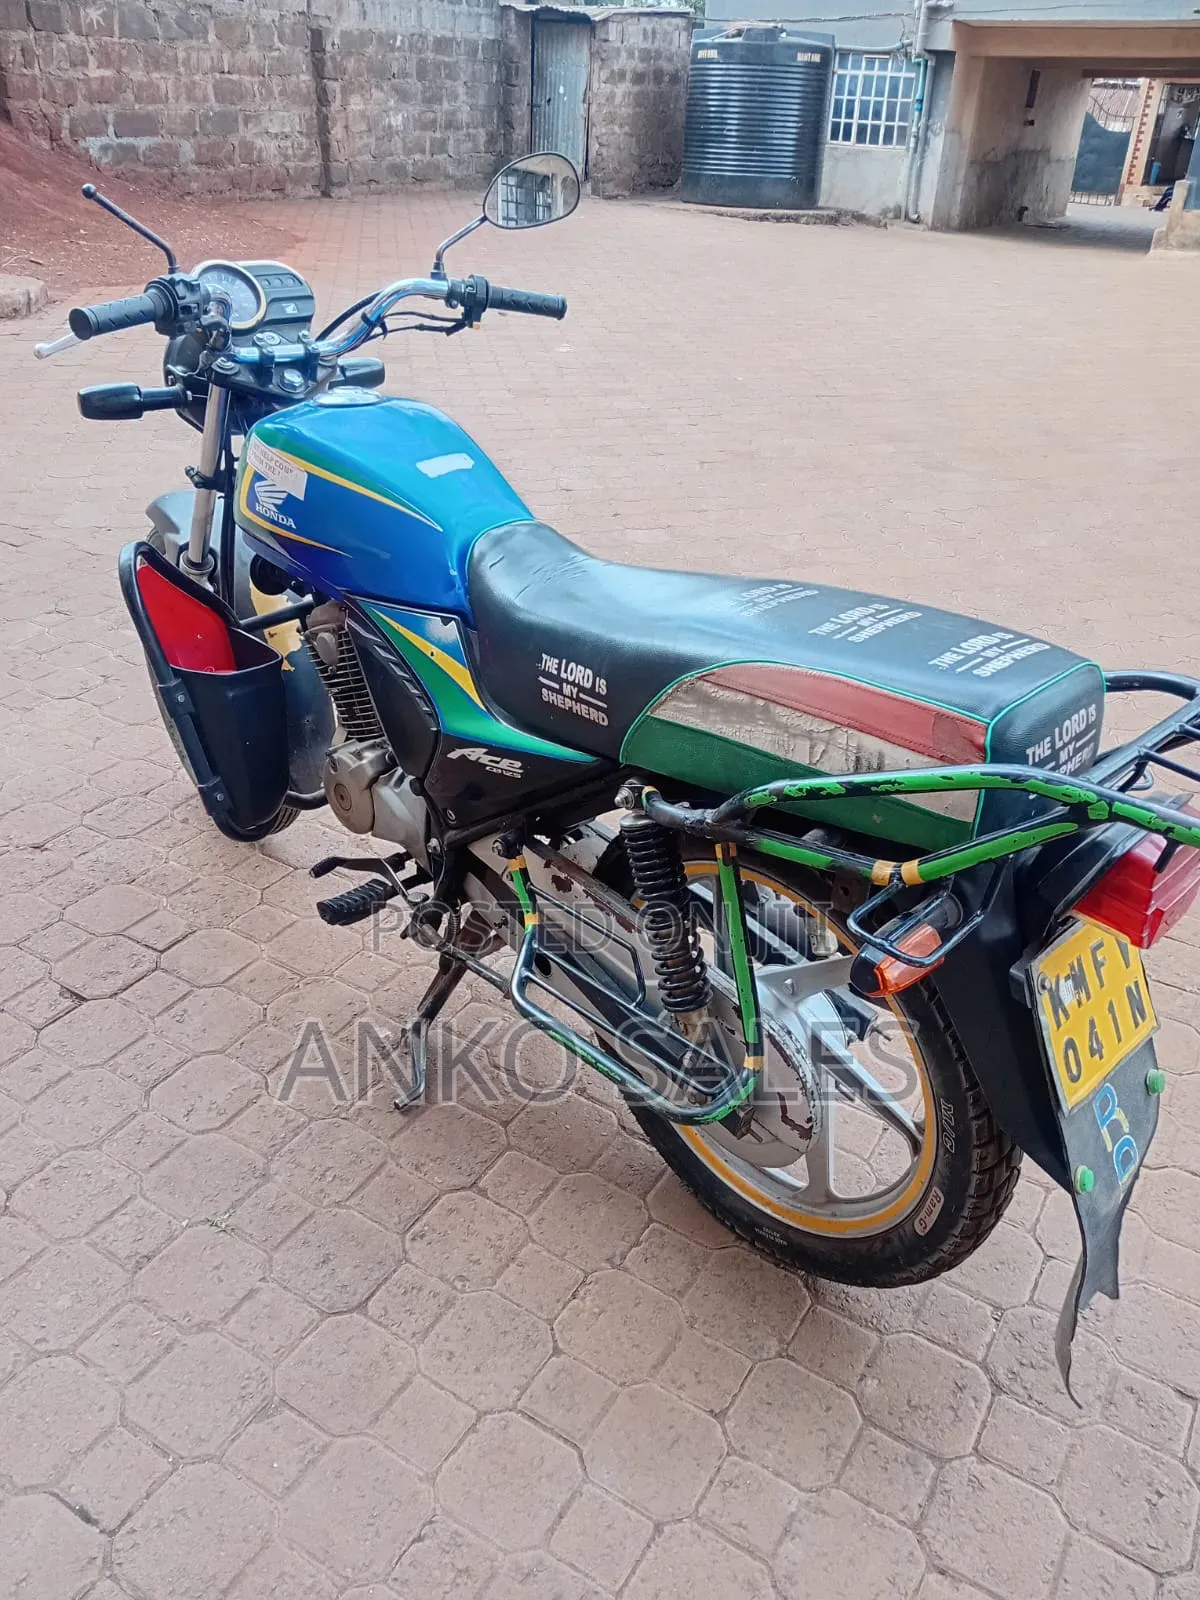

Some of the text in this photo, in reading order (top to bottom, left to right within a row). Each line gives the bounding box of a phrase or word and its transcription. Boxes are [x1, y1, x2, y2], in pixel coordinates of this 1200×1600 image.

[255, 502, 296, 529] HONDA
[808, 603, 890, 636] THE LORD IS
[847, 611, 922, 643] SHEPHERD
[857, 616, 878, 627] MY
[928, 632, 1015, 670] THE LORD IS
[972, 642, 1051, 678] SHEPHERD
[980, 647, 1005, 658] MY
[540, 653, 607, 696] THE LORD IS
[562, 682, 578, 699] MY
[541, 688, 609, 727] SHEPHERD
[1025, 703, 1097, 766] THE LORD IS
[1059, 741, 1077, 764] MY
[1063, 977, 1147, 1084] 041N
